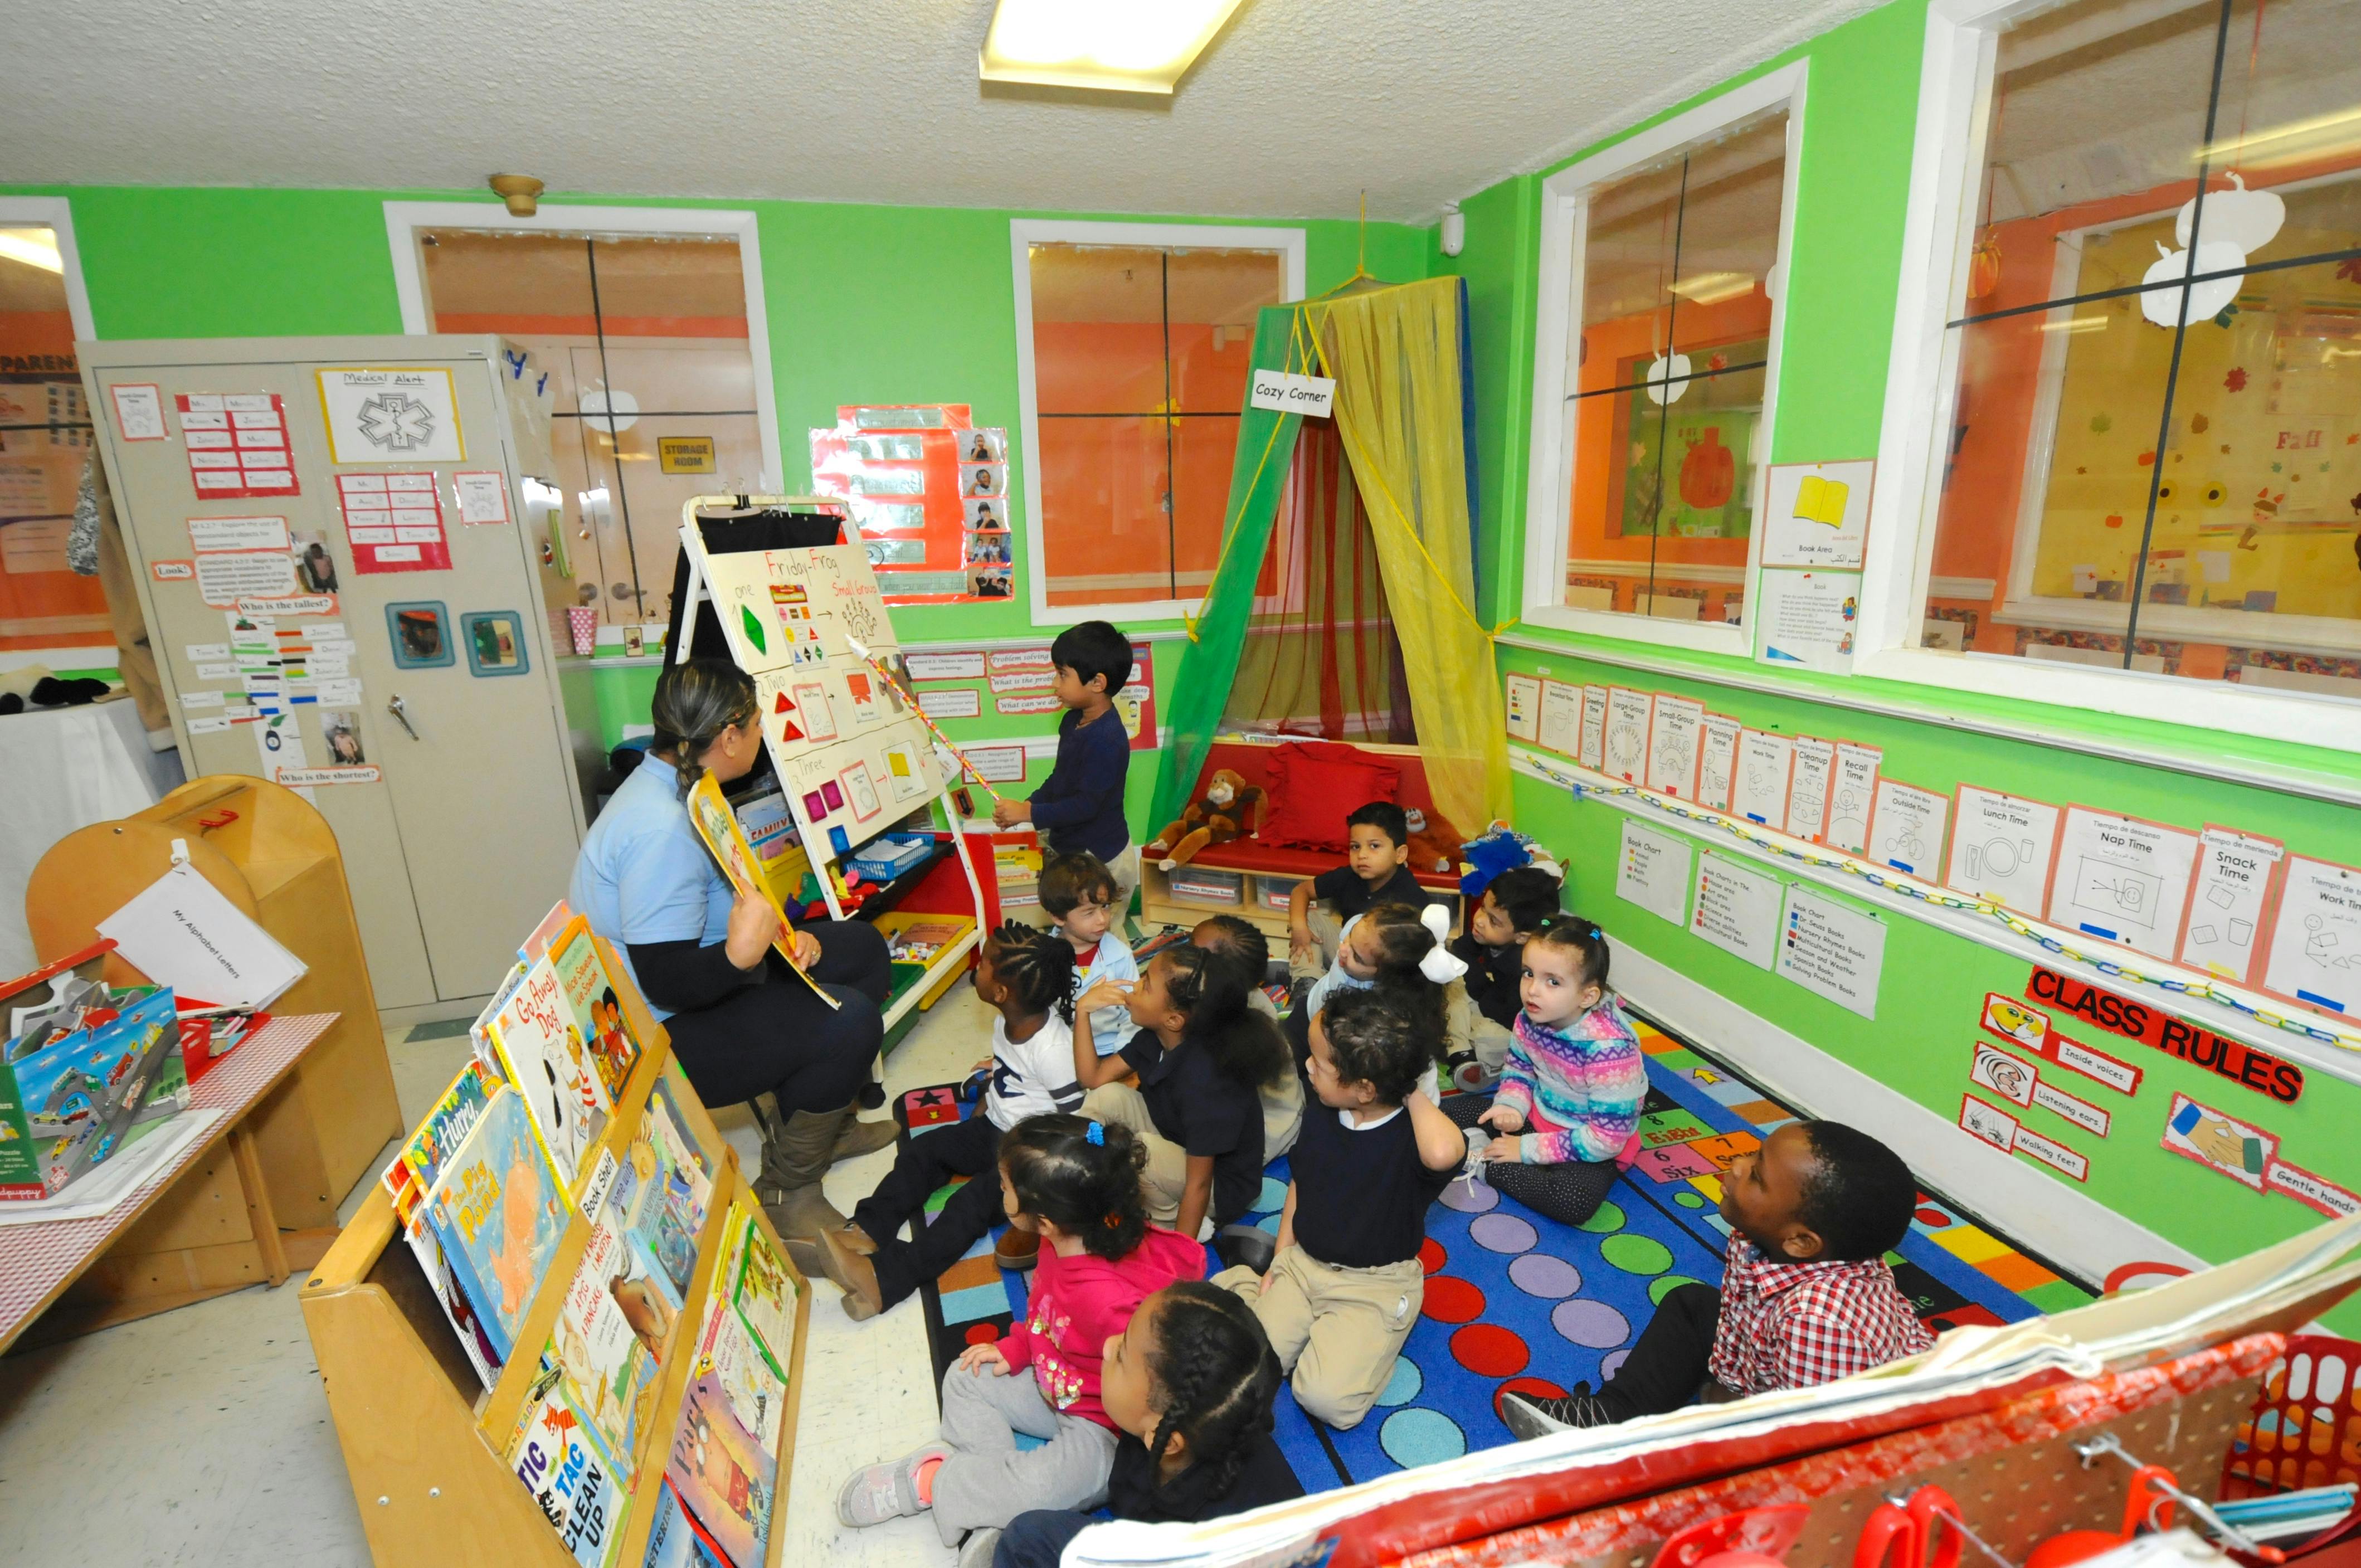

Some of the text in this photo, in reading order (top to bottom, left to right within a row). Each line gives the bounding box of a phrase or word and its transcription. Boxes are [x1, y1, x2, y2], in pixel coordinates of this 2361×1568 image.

[344, 373, 425, 383] Medical Alert
[1256, 383, 1326, 402] Cozy Corner
[2276, 430, 2323, 449] Fall
[665, 445, 708, 454] STORAGE
[674, 457, 703, 466] ROOM
[157, 564, 188, 575] Look!
[736, 585, 754, 598] one
[833, 580, 854, 597] Small
[295, 599, 329, 608] tallest?
[764, 675, 786, 692] Two
[1586, 697, 1604, 708] Greeting
[1589, 705, 1599, 714] Time
[1613, 700, 1646, 715] Large-Group
[1623, 711, 1634, 720] Time
[1659, 710, 1695, 725] Small-Group
[1669, 722, 1682, 731] Time
[1708, 728, 1733, 741] Planning
[1712, 737, 1726, 747] Time
[796, 758, 825, 776] Three
[1799, 751, 1828, 766] Cleanup
[1804, 762, 1820, 772] Time
[1845, 759, 1868, 772] Recall
[280, 773, 303, 782] Who
[333, 770, 376, 779] shortest?
[1846, 770, 1864, 781] Time
[1892, 798, 1930, 815] Outside Time
[1979, 796, 1999, 809] Tiempo
[2008, 802, 2031, 814] almorzar
[1983, 809, 2028, 827] Lunch Time
[2094, 820, 2118, 832] Tiempo
[2130, 827, 2161, 840] descanso
[1628, 836, 1661, 856] Book Chart
[2101, 832, 2153, 854] Nap Time
[2204, 834, 2279, 857] Tiempo de merienda
[2217, 851, 2257, 871] Snack
[1703, 866, 1731, 884] Book Charts
[2219, 865, 2250, 882] Time
[1724, 887, 1735, 895] area
[2311, 876, 2340, 890] Tiempo
[1720, 903, 1731, 912] area
[2320, 892, 2344, 905] Work
[1724, 914, 1735, 923] area
[1793, 902, 1825, 921] Book Chart
[1703, 922, 1748, 947] Multicultural Books
[1809, 920, 1844, 939] Seuss Books
[173, 909, 240, 978] My Alphabet Letters
[1797, 936, 1852, 964] Multicultural Books
[1798, 925, 1866, 960] Nursery Rhymes Books
[1794, 955, 1834, 977] Spanish Books
[1795, 944, 1815, 958] Season
[1830, 960, 1857, 976] Weather
[564, 976, 578, 995] Mice
[1792, 964, 1856, 997] Solving Problem Books
[516, 971, 559, 1024] Go Away,
[574, 991, 585, 1007] We
[536, 1004, 562, 1039] Dog
[2032, 971, 2303, 1102] CLASS RULES
[2065, 1047, 2127, 1083] Inside voices.
[2038, 1090, 2101, 1129] Listening ears.
[1647, 1115, 1664, 1126] 8
[1644, 1127, 1702, 1144] Eight
[1715, 1137, 1734, 1149] 7
[1653, 1150, 1671, 1162] 6
[2020, 1134, 2078, 1170] Walking feet.
[461, 1159, 489, 1196] Pig
[1661, 1165, 1701, 1179] Six
[583, 1152, 614, 1218] Book Shelf
[2277, 1171, 2355, 1213] Gentle hands
[459, 1168, 500, 1246] Pond
[610, 1183, 625, 1214] home
[588, 1221, 604, 1250] MOOSE
[593, 1231, 612, 1263] MUFFIN
[575, 1279, 590, 1312] A PIG
[581, 1285, 602, 1340] A PANCAKE
[514, 1400, 536, 1439] READ!
[517, 1441, 547, 1495] TIC
[554, 1443, 585, 1499] TAC
[562, 1462, 602, 1555] CLEAN
[585, 1504, 605, 1548] UP
